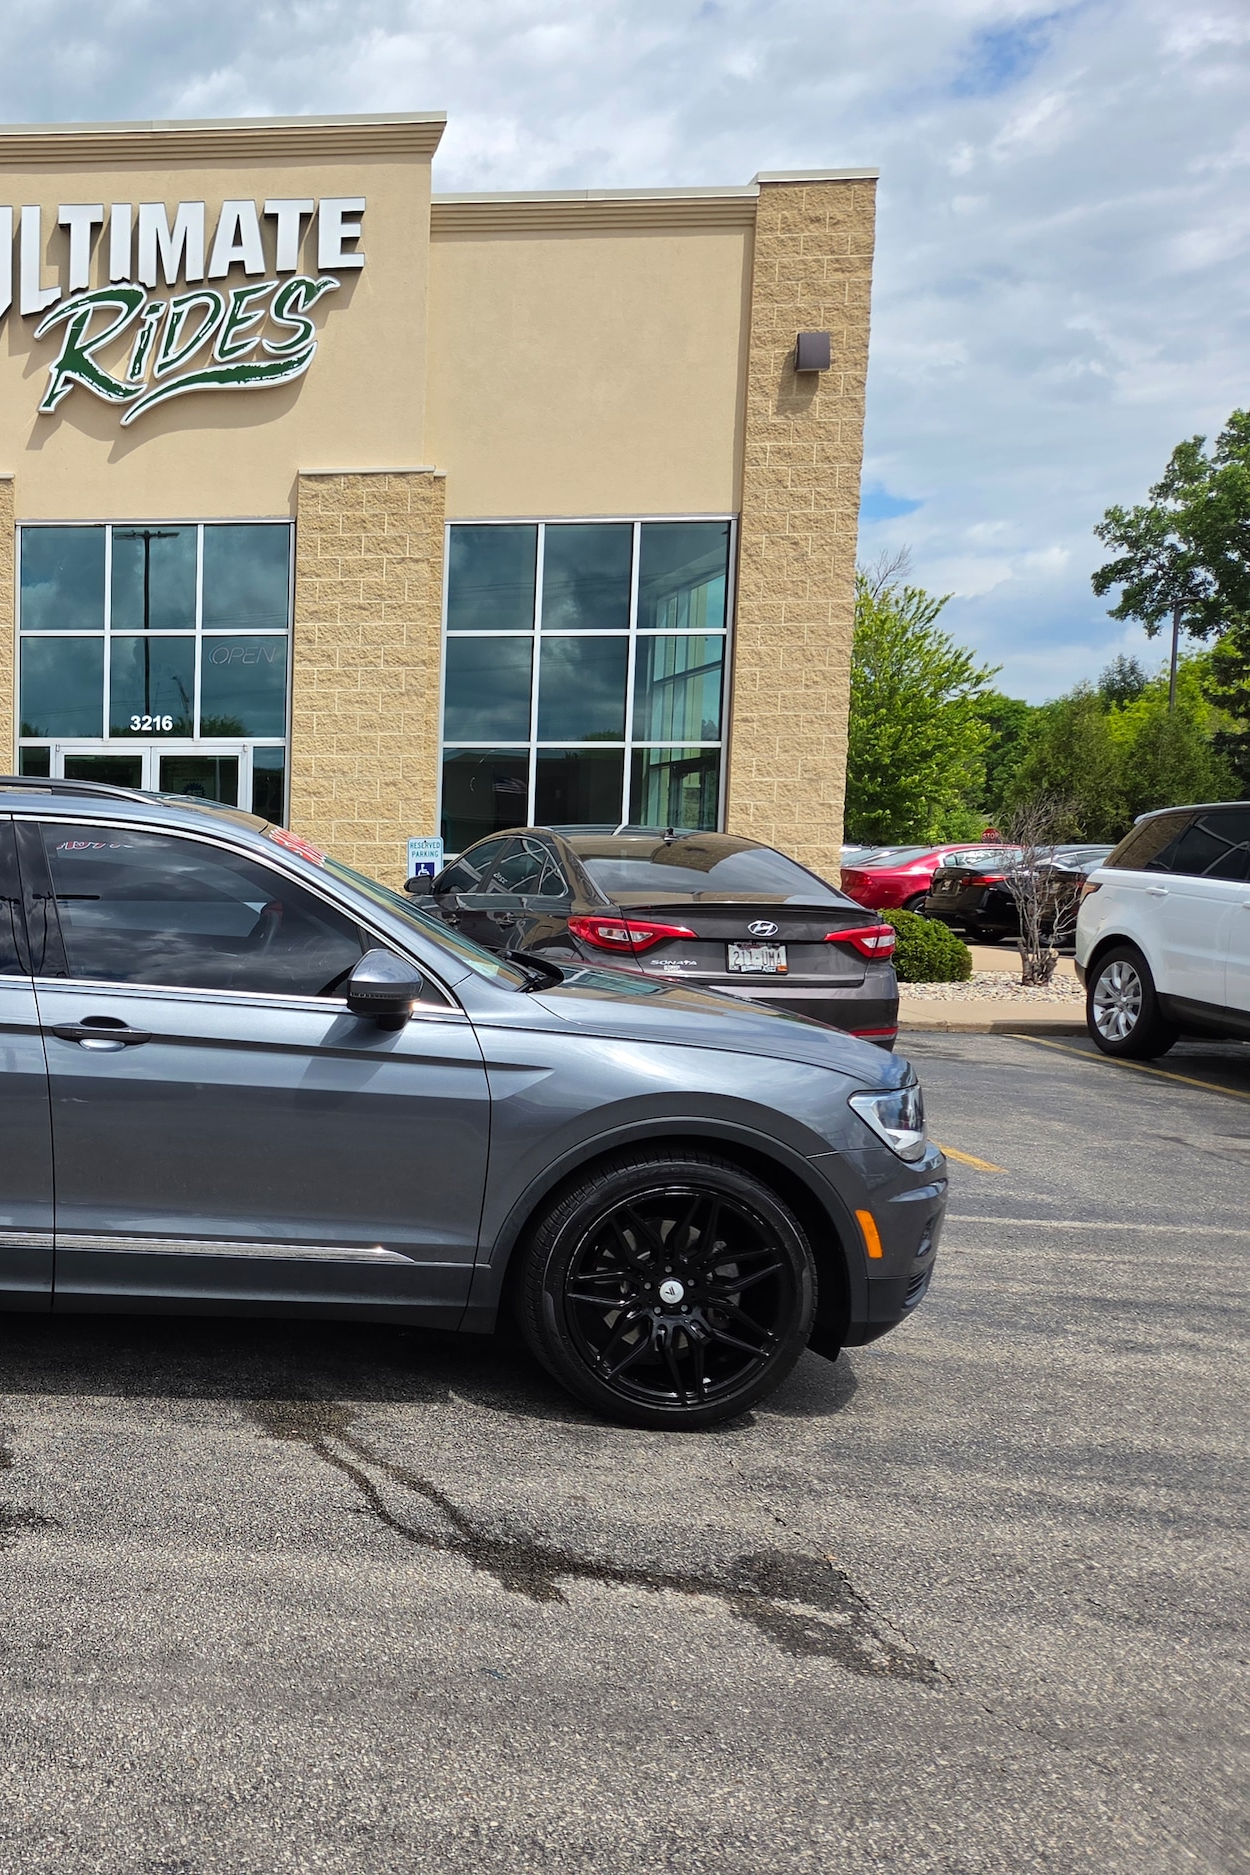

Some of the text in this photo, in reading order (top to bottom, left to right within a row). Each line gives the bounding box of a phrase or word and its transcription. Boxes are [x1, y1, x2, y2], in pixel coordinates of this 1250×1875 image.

[211, 646, 277, 665] OPEN
[130, 715, 173, 731] 3216
[982, 832, 1000, 840] STOP
[409, 841, 441, 849] RESERVED
[411, 850, 439, 858] PARKING
